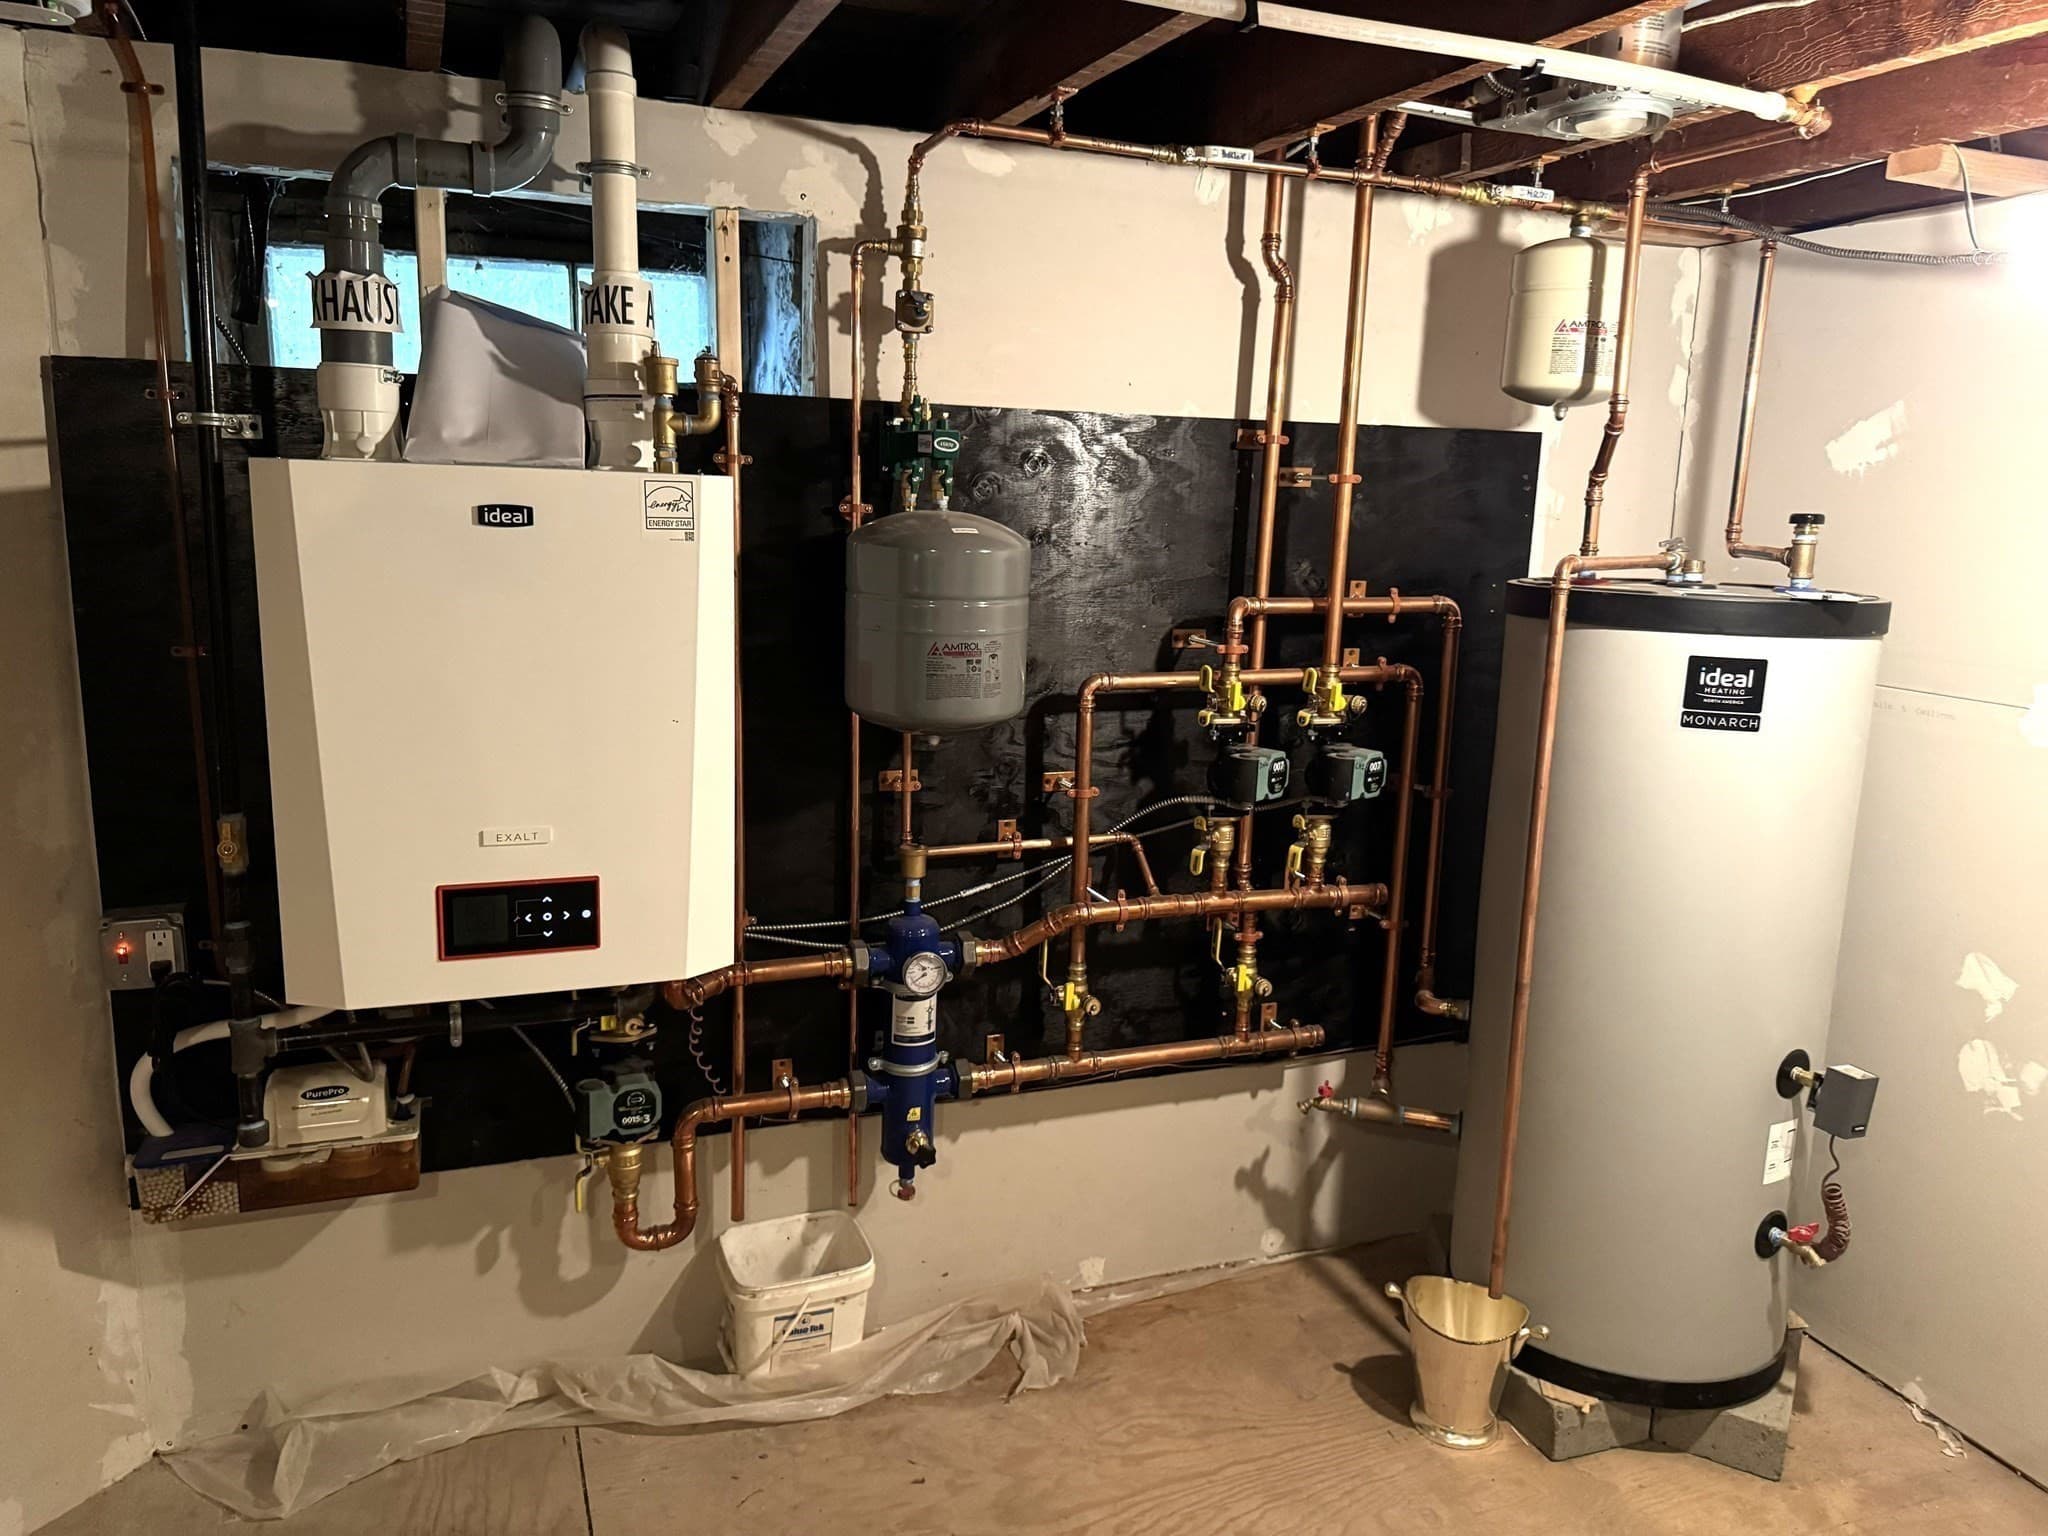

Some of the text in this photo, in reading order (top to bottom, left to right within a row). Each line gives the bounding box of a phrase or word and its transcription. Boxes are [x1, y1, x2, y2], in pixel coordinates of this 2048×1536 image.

[484, 507, 528, 524] ideal
[648, 519, 674, 527] ENERGY
[942, 642, 981, 651] AMTROL
[1699, 666, 1754, 688] ideal
[1704, 687, 1745, 696] HEATING
[1682, 714, 1758, 729] MONARCH
[496, 832, 538, 842] EXALT
[306, 1088, 345, 1099] PurePro
